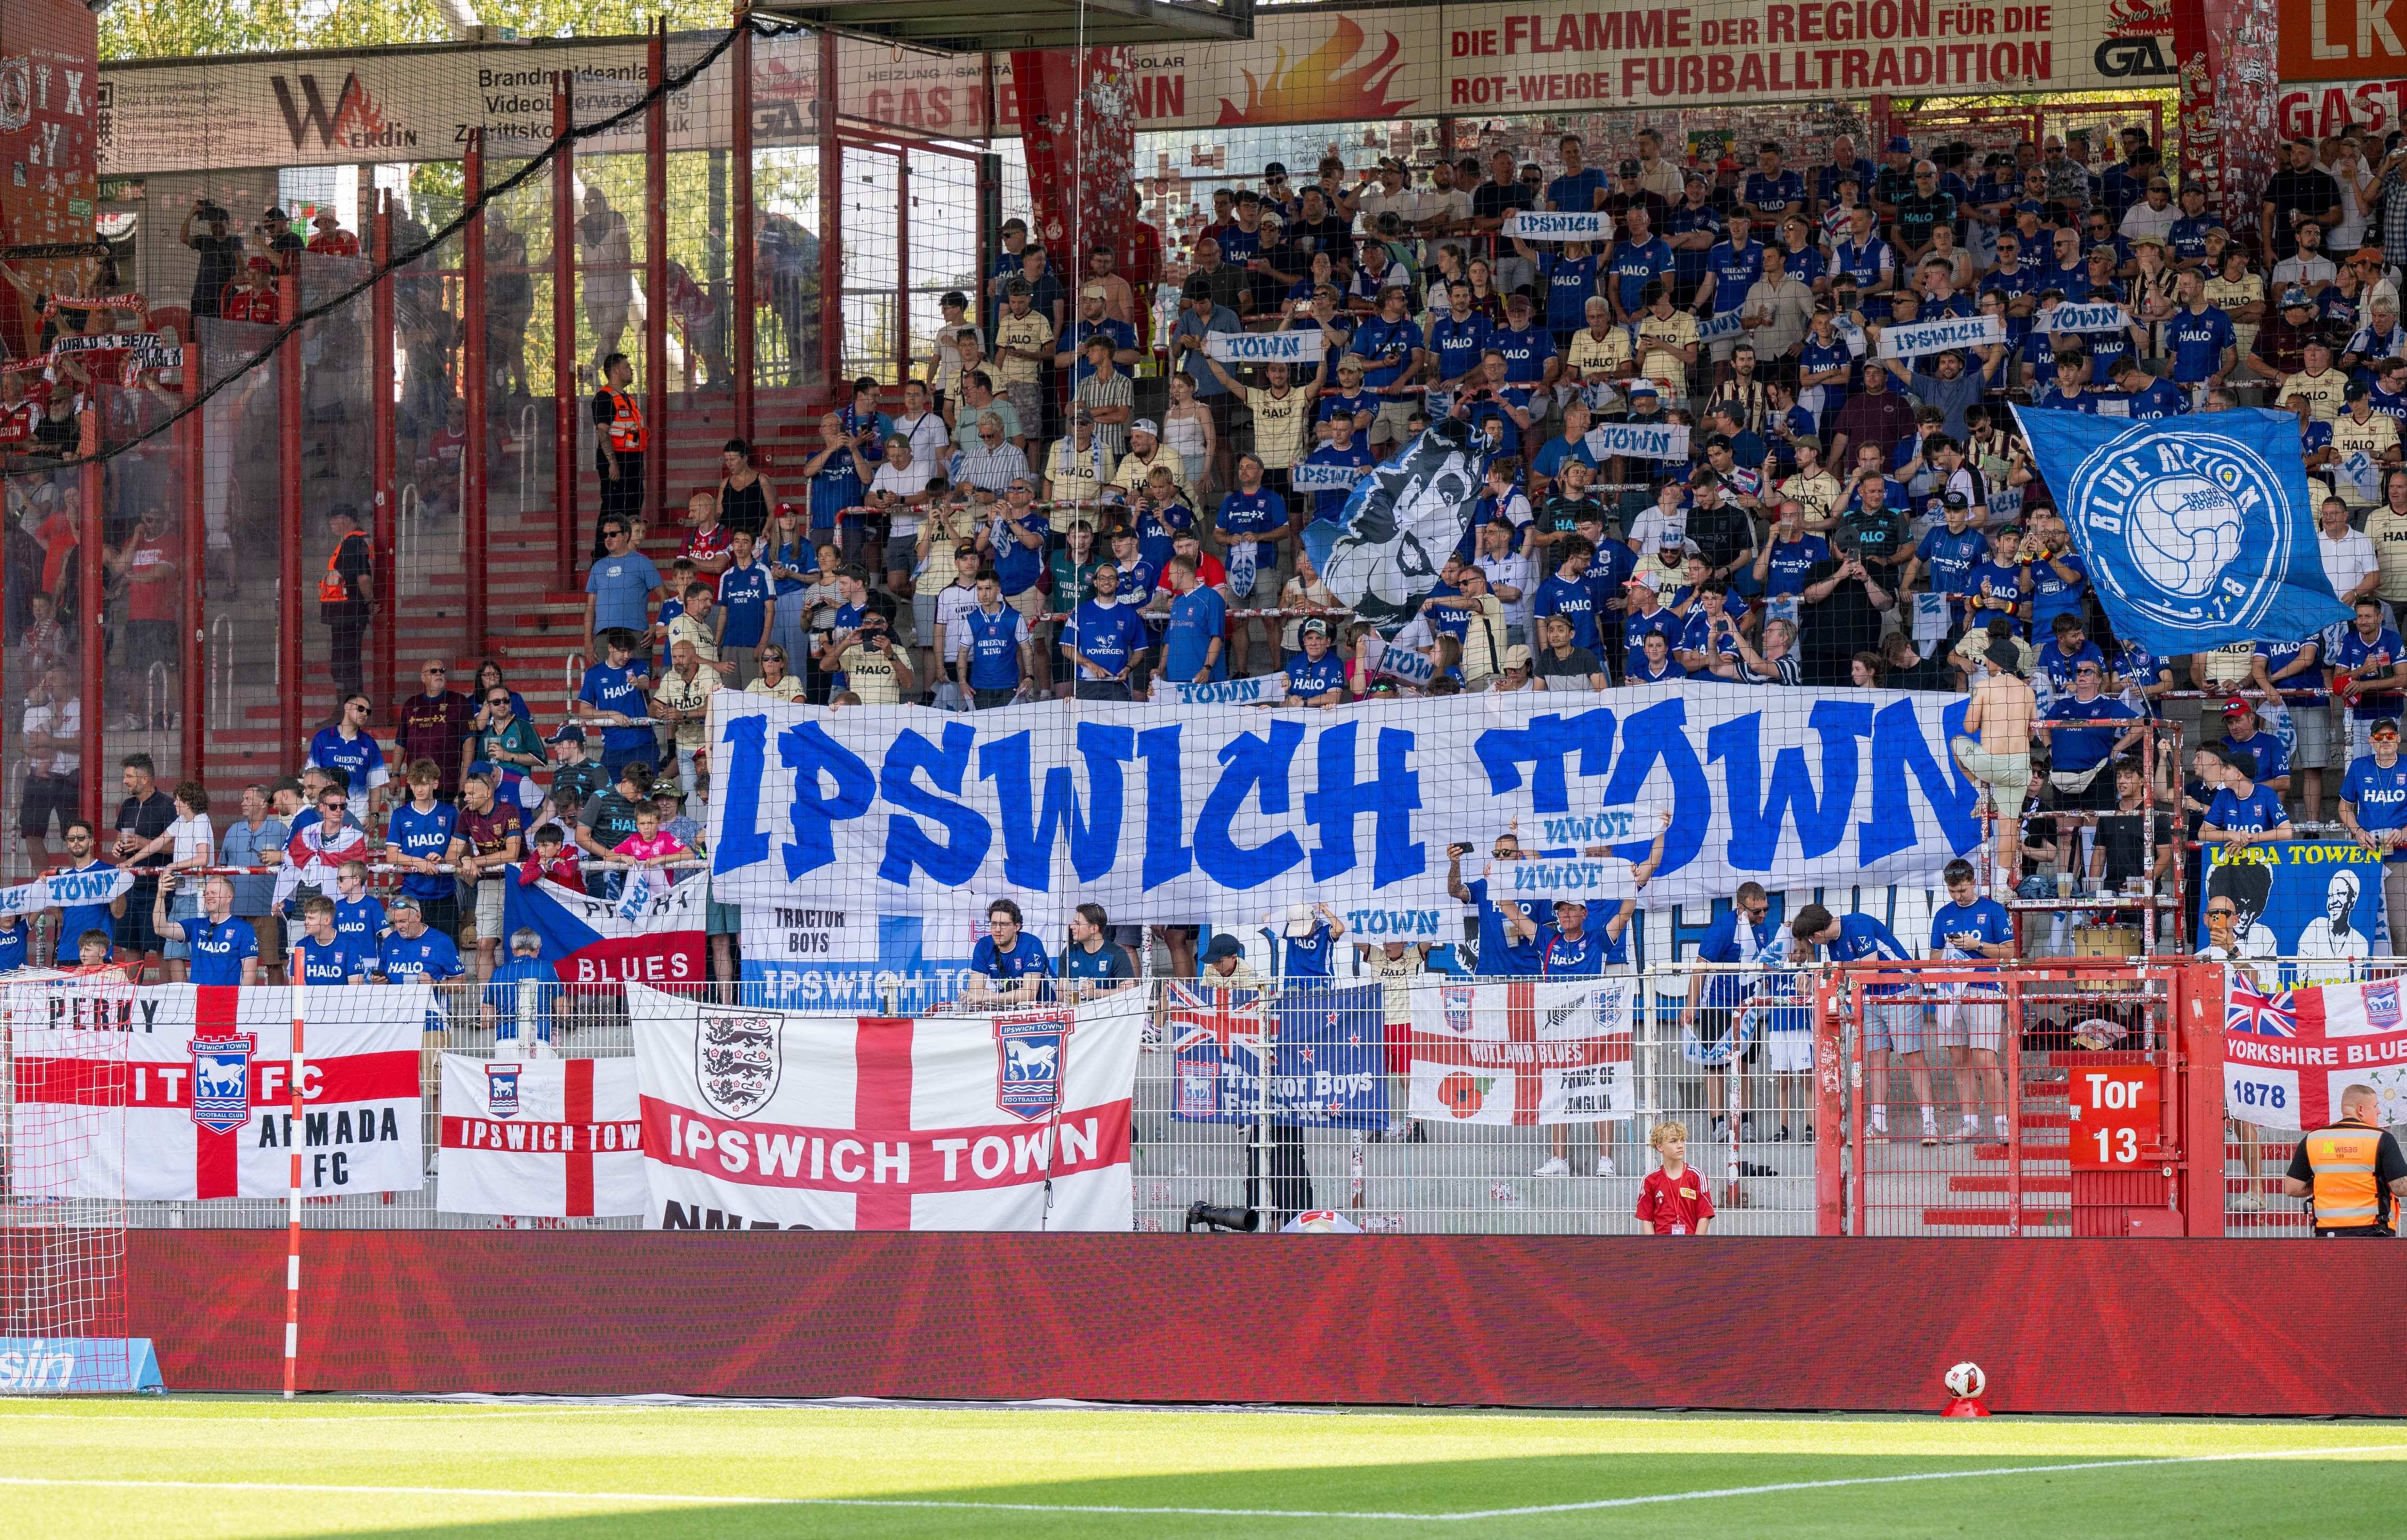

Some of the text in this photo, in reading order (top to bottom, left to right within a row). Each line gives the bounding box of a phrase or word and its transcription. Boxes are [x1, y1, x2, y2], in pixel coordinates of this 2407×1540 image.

[2128, 10, 2150, 23] 100
[1452, 0, 2052, 57] DIE FLAMME DER REGION FÜR DIE
[1133, 57, 1185, 68] SOLAR
[2095, 37, 2178, 78] GA
[868, 61, 1012, 82] HEIZUNG SANTÄ
[868, 85, 951, 131] GAS
[1759, 200, 1786, 212] HALO
[1520, 212, 1599, 232] IPSWICH
[1904, 212, 1933, 224] HALO
[1619, 265, 1649, 276] HALO
[1721, 267, 1752, 275] GREENE
[1551, 275, 1581, 287] HALO
[2218, 296, 2251, 307] HALO
[2051, 305, 2119, 328] TOWN
[1893, 318, 1986, 351] IPSWICH
[2178, 330, 2211, 342] HALO
[1227, 336, 1300, 358] TOWN
[1442, 337, 1473, 349] HALO
[2094, 342, 2125, 353] HALO
[1583, 356, 1614, 368] HALO
[1812, 363, 1838, 373] HALO
[1262, 406, 1291, 418] HALO
[2370, 406, 2406, 419] HALO
[1603, 428, 1672, 453] TOWN
[2342, 439, 2374, 451] HALO
[1859, 531, 1885, 543] ALO
[688, 549, 714, 560] HALO
[1941, 565, 1956, 573] TOUR
[1059, 581, 1090, 592] GREENE
[1989, 587, 2018, 599] ALO
[1062, 590, 1081, 599] KING
[1559, 599, 1591, 613] HALO
[978, 638, 1007, 648] GREENE
[2269, 642, 2299, 657] HALO
[983, 646, 1001, 655] KING
[855, 665, 892, 675] HALO
[1293, 677, 1325, 690] HALO
[603, 683, 635, 700] HALO
[1176, 679, 1261, 705] TOWN
[673, 696, 702, 709] HALO
[333, 753, 364, 765] GREENE
[713, 697, 1983, 892] IPSWICH TOWN
[2363, 789, 2405, 804] HALO
[611, 819, 638, 831] HAL
[407, 832, 444, 848] HALO
[2210, 843, 2382, 867] UPPA TOWEN
[49, 871, 120, 902] TOWN
[337, 922, 365, 933] HALO
[1345, 908, 1440, 936] TOWN
[197, 939, 230, 953] HALO
[788, 932, 829, 953] BOYS
[1546, 952, 1583, 965] HALO
[306, 964, 342, 978] HALO
[387, 961, 424, 975] HALO
[578, 952, 689, 982] BLUES
[762, 968, 922, 1000] IPSWICH
[49, 996, 159, 1033] PERKY
[2227, 1037, 2339, 1065] YORKSHIRE
[1222, 1061, 1374, 1099] Trator Boys
[2086, 1074, 2143, 1110] Tor
[2233, 1080, 2286, 1108] 1878
[462, 1120, 573, 1151] IPSWICH
[670, 1113, 1098, 1183] IPSWICH TOWN
[2093, 1127, 2137, 1164] 13
[314, 1151, 349, 1188] FC
[0, 1339, 74, 1388] sin
